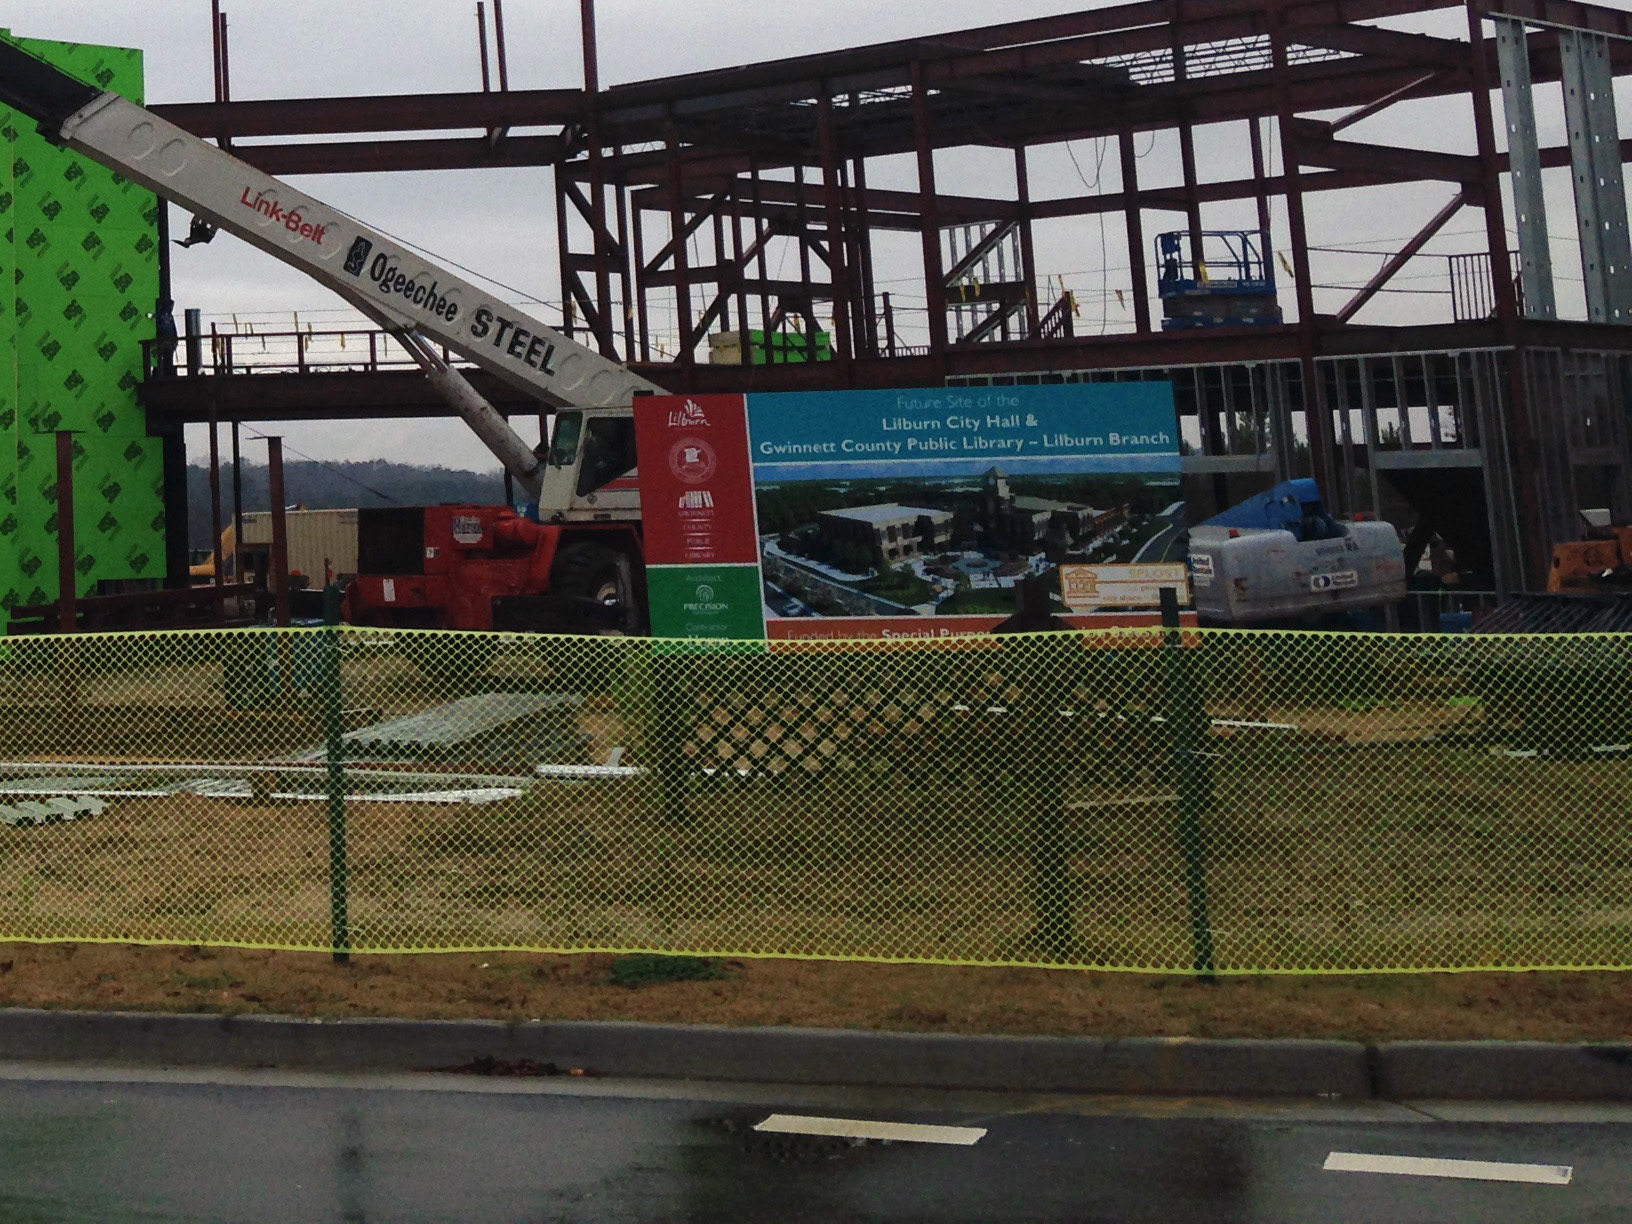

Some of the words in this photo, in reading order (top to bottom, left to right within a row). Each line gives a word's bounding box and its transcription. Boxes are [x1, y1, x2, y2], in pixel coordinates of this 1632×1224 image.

[240, 186, 325, 245] Link-Belt
[370, 253, 458, 322] Ogeechee
[470, 308, 556, 376] STEEL
[897, 395, 941, 410] Future
[946, 394, 972, 409] Site
[977, 394, 992, 407] of
[997, 394, 1020, 407] the
[882, 417, 941, 431] Lilburn
[946, 415, 980, 431] City
[986, 414, 1020, 428] Hall
[1025, 413, 1038, 427] &
[759, 441, 837, 455] Gwinnett
[841, 439, 902, 455] County
[907, 437, 958, 451] Public
[962, 435, 1024, 451] Library
[1043, 433, 1103, 448] Lilburn
[1109, 431, 1170, 446] Branch
[683, 602, 729, 611] PRECISION
